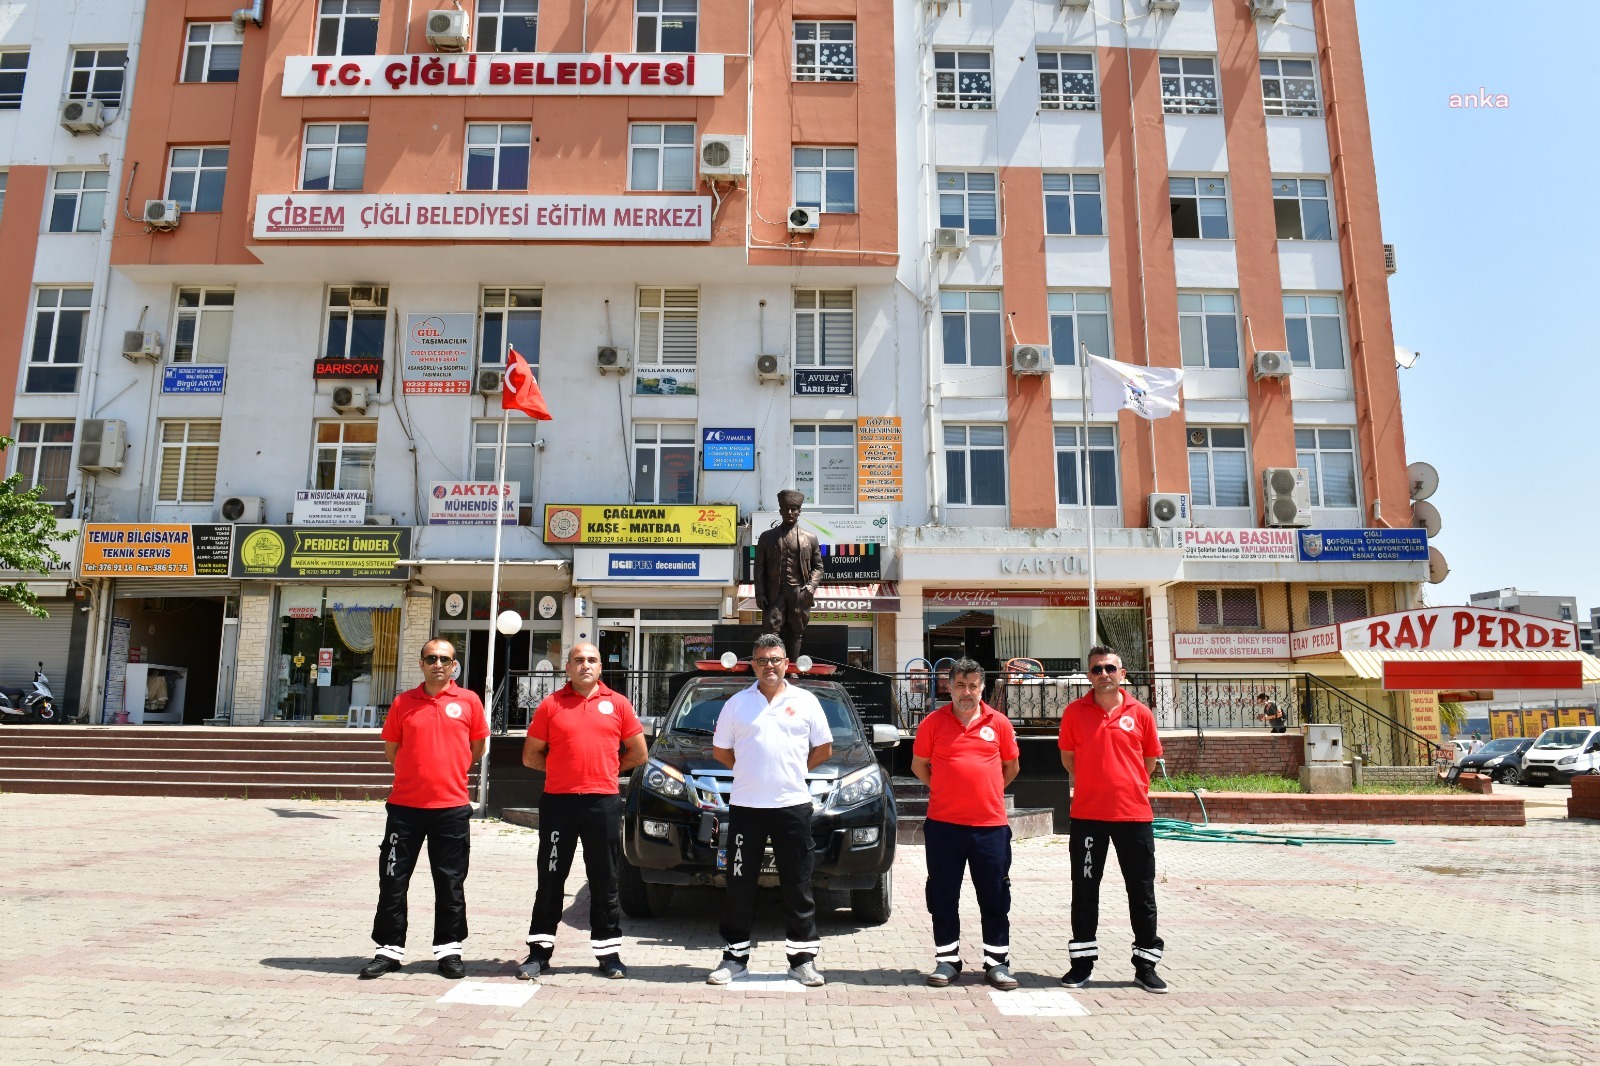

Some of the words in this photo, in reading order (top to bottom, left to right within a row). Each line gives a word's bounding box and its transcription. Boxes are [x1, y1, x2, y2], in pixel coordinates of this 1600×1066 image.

[311, 63, 371, 86] T.C.
[384, 54, 477, 90] ÇİĞLİ
[489, 54, 695, 85] BELEDİYESİ
[267, 197, 345, 228] ÇİBEM
[360, 202, 411, 229] ÇİĞLİ
[416, 202, 529, 226] BELEDİYESİ
[536, 203, 606, 227] EĞİTİM
[613, 204, 702, 227] MERKEZİ
[417, 327, 440, 337] GÜL
[421, 338, 468, 346] TAŞIMACILIK
[316, 363, 379, 374] BARISCAN
[807, 374, 840, 382] AVUKAT
[176, 380, 197, 388] Birgül
[801, 385, 825, 394] BARIŞ
[826, 384, 846, 393] İPEK
[866, 417, 893, 426] GÖZDE
[345, 491, 366, 500] AYKAL
[444, 499, 514, 511] MÜHENDİSİK
[603, 507, 666, 521] ÇAĞLAYAN
[587, 522, 619, 536] KAŞE
[629, 523, 681, 533] MATBAA
[1363, 530, 1382, 538] ÇİĞLİ
[88, 531, 124, 543] TEMUR
[127, 528, 189, 544] BİLGİSAYAR
[1185, 531, 1236, 544] PLAKA
[1239, 531, 1293, 545] BASIMI
[303, 536, 350, 551] PERDECİ
[352, 537, 390, 551] ÖNDER
[1367, 545, 1425, 553] KAMYONETÇİLER
[102, 546, 135, 558] TEKNİK
[137, 546, 171, 558] SERVİS
[1240, 546, 1294, 554] YAPILMAKTADIR
[831, 554, 861, 564] FOTOKOPİ
[84, 563, 97, 571] Tel:
[98, 563, 112, 571] 376
[136, 564, 151, 572] Fax:
[152, 564, 166, 572] 386
[655, 560, 697, 570] deceuninck
[1000, 556, 1089, 575] KARTÜL
[836, 571, 853, 579] BASKI
[854, 570, 880, 579] MERKEZİ
[810, 600, 872, 610] OTOKOPİ
[1452, 611, 1572, 649] PERDE
[1177, 636, 1204, 645] JALUZİ
[1210, 637, 1231, 645] STOR
[1237, 635, 1260, 645] DİKEY
[1262, 636, 1287, 645] PERDE
[1292, 636, 1309, 651] ERAY
[1312, 631, 1335, 648] PERDE
[1192, 646, 1227, 655] MEKANİK
[1229, 646, 1274, 655] SİSTEMLERİ
[386, 832, 398, 877] ÇAK
[548, 830, 560, 872] ÇAK
[733, 833, 744, 877] ÇAK
[1083, 836, 1094, 879] ÇAK
